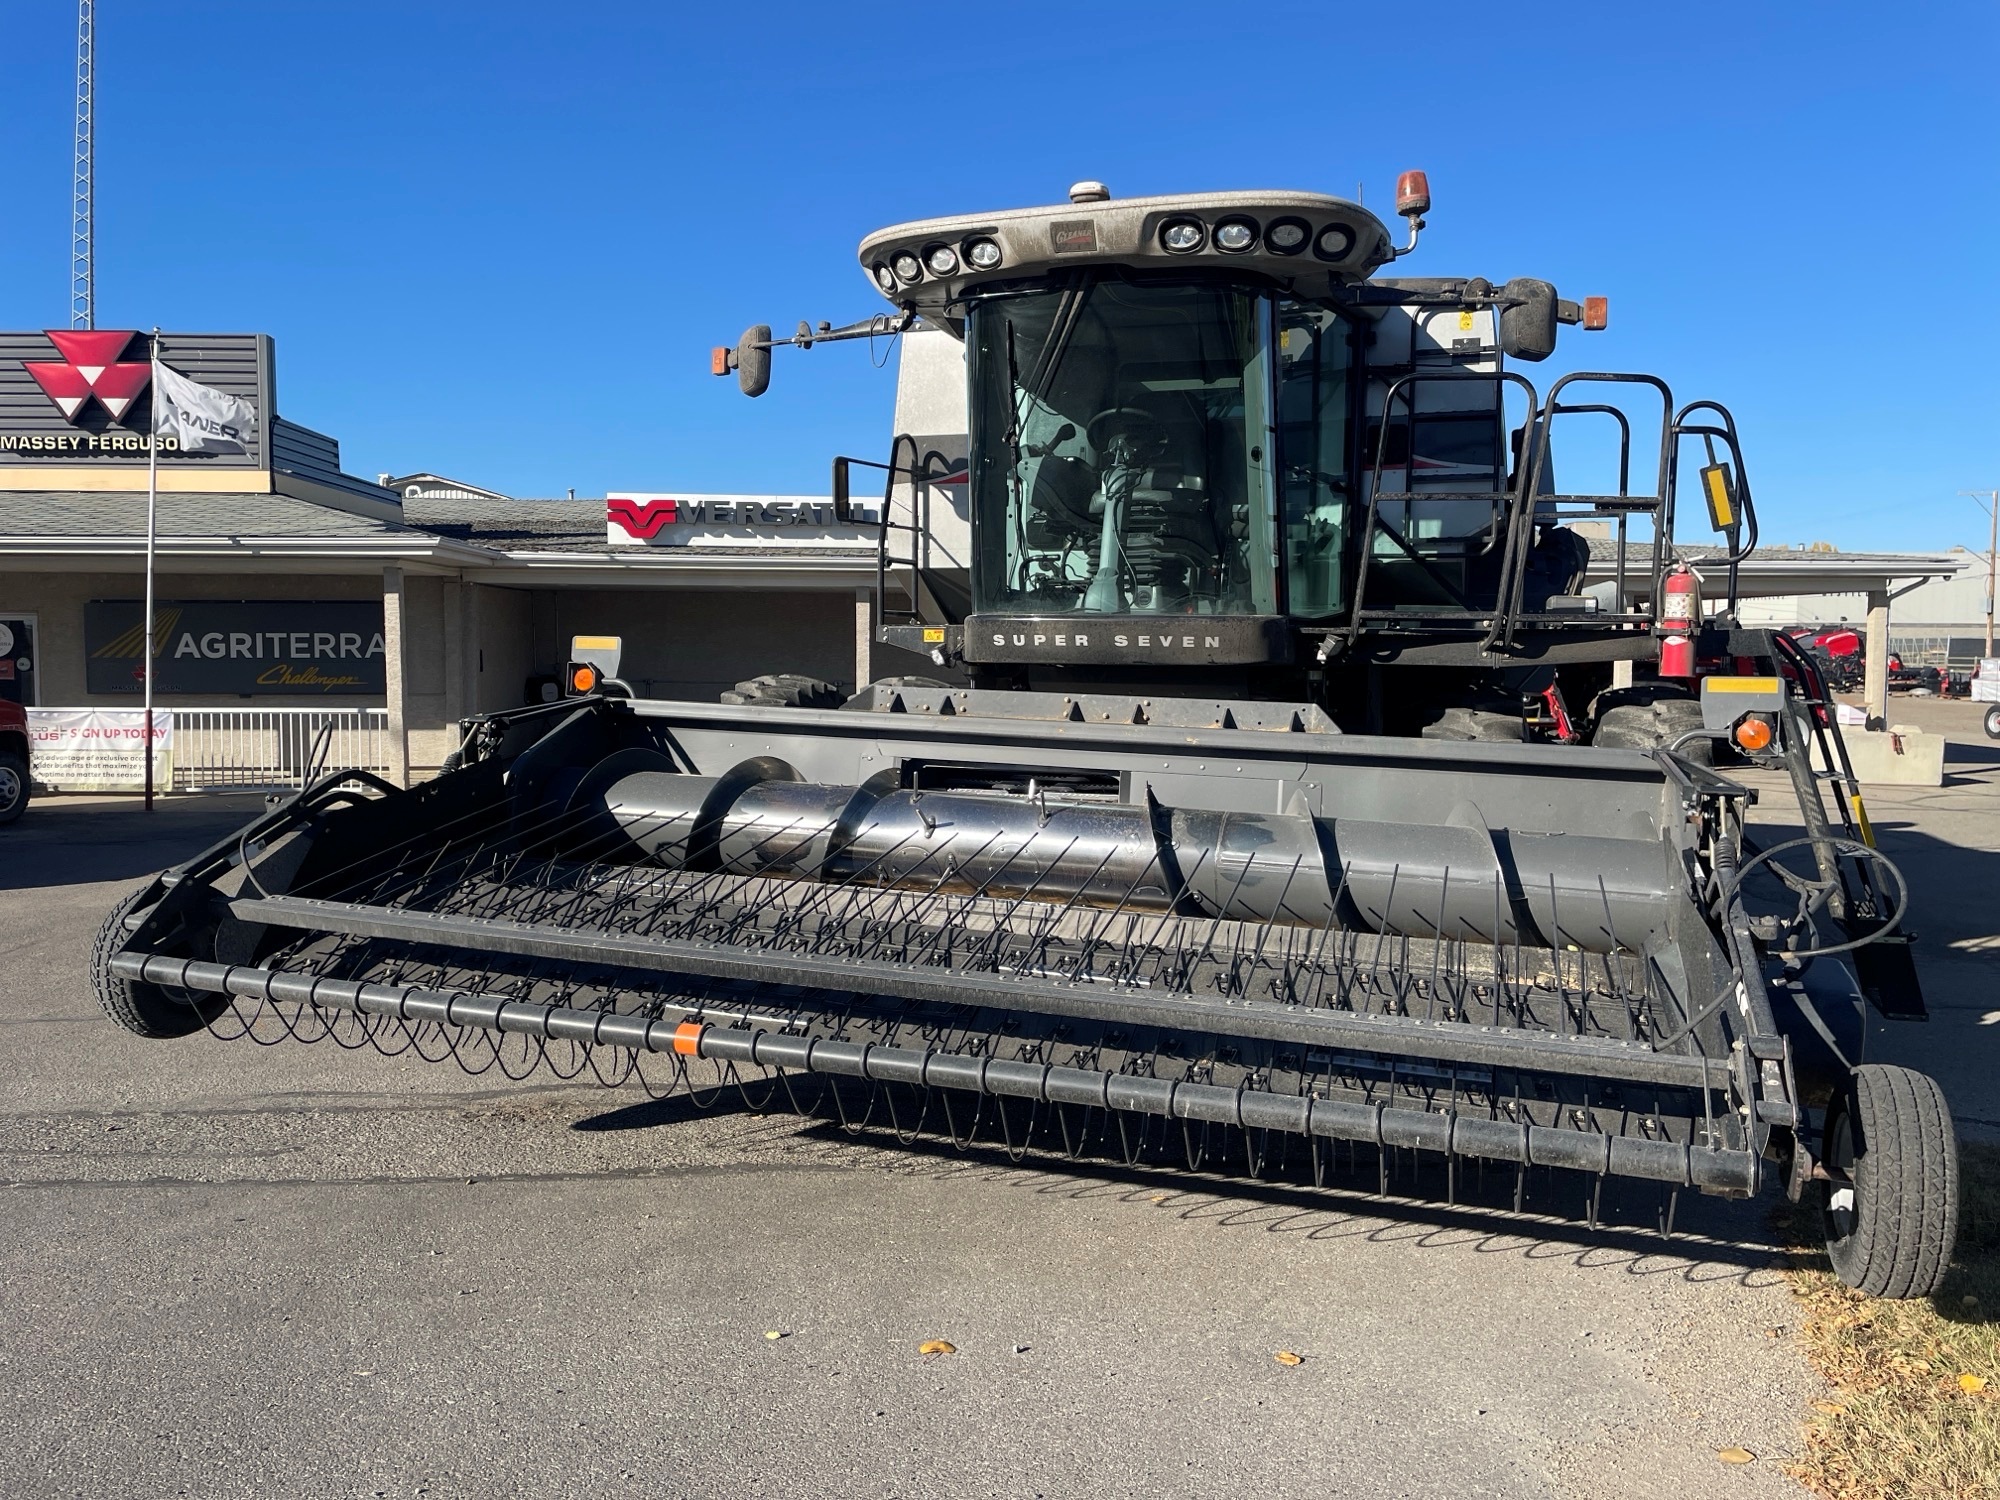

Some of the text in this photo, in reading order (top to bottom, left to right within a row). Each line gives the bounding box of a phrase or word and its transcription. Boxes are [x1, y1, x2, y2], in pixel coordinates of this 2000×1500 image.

[0, 436, 179, 450] MASSEY FERGUSO
[677, 500, 886, 527] VERSATL
[174, 632, 386, 659] AGRITERRA
[992, 634, 1220, 648] SUPER SEVEN
[256, 664, 369, 692] Challenger
[30, 732, 60, 741] LUS
[70, 728, 100, 738] SGN
[103, 728, 121, 739] UP
[46, 755, 85, 763] advantage
